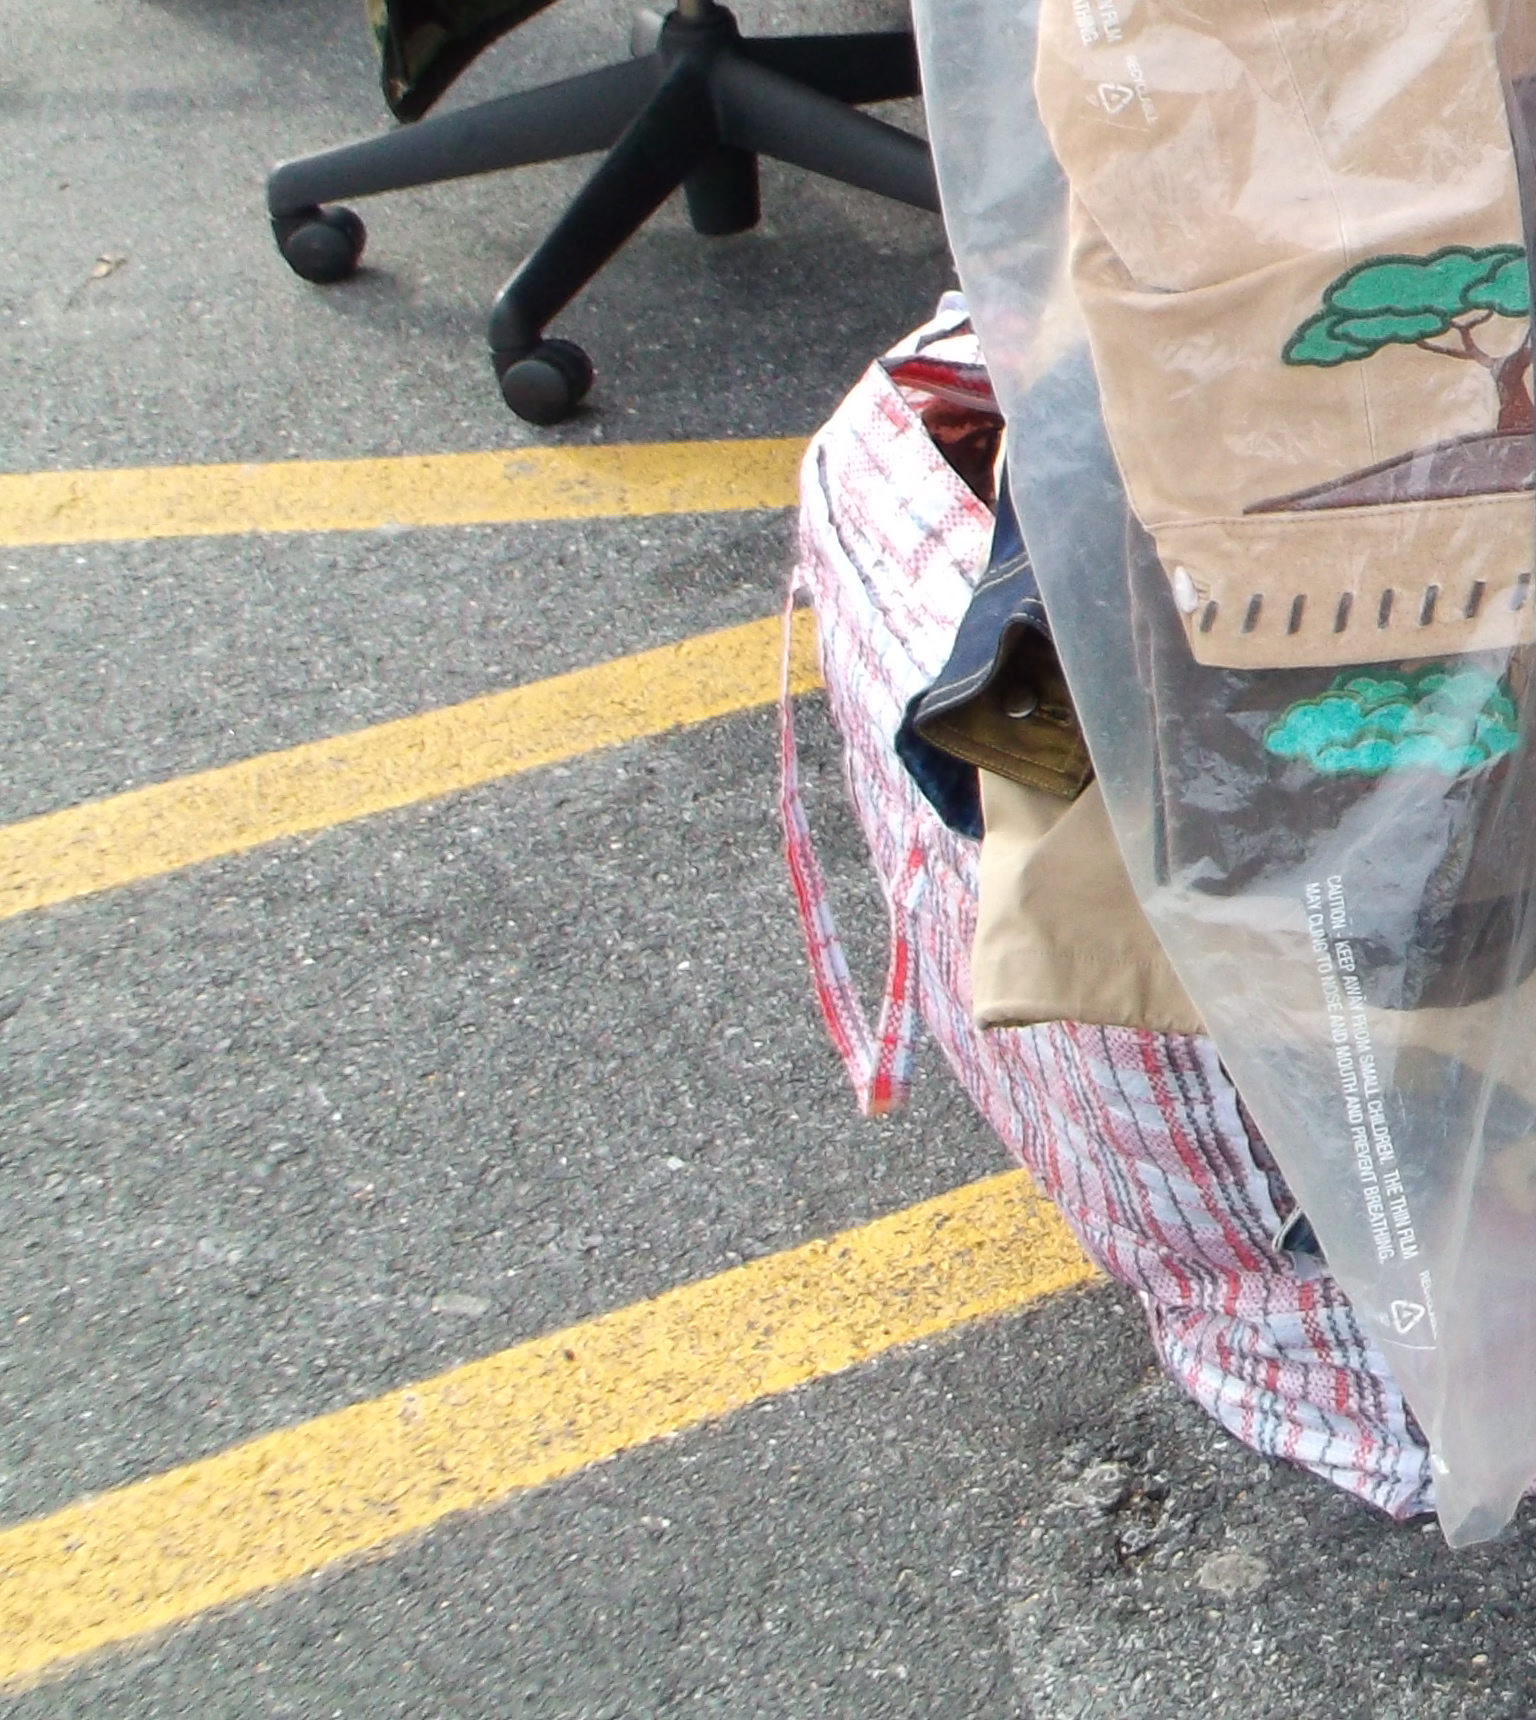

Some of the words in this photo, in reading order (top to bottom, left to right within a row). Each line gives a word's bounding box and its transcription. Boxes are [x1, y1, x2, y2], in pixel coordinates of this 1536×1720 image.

[1305, 882, 1323, 910] MAY
[1327, 875, 1347, 930] CAUTION
[1309, 913, 1330, 953] CLING
[1317, 956, 1334, 974] TO
[1333, 941, 1355, 972] KEEP
[1322, 976, 1344, 1012] NOSE
[1342, 976, 1361, 1011] AWAY
[1329, 1015, 1348, 1042] AND
[1352, 1014, 1372, 1052] FROM
[1335, 1045, 1358, 1092] MOUTH
[1359, 1054, 1382, 1098] SMALL
[1345, 1096, 1364, 1123] AND
[1368, 1100, 1393, 1165] CHILDREN.
[1350, 1126, 1377, 1183] PREVENT
[1384, 1169, 1403, 1196] THE
[1363, 1187, 1394, 1264] BREATHING.
[1391, 1195, 1411, 1227] THIN
[1396, 1228, 1419, 1260] FILM
